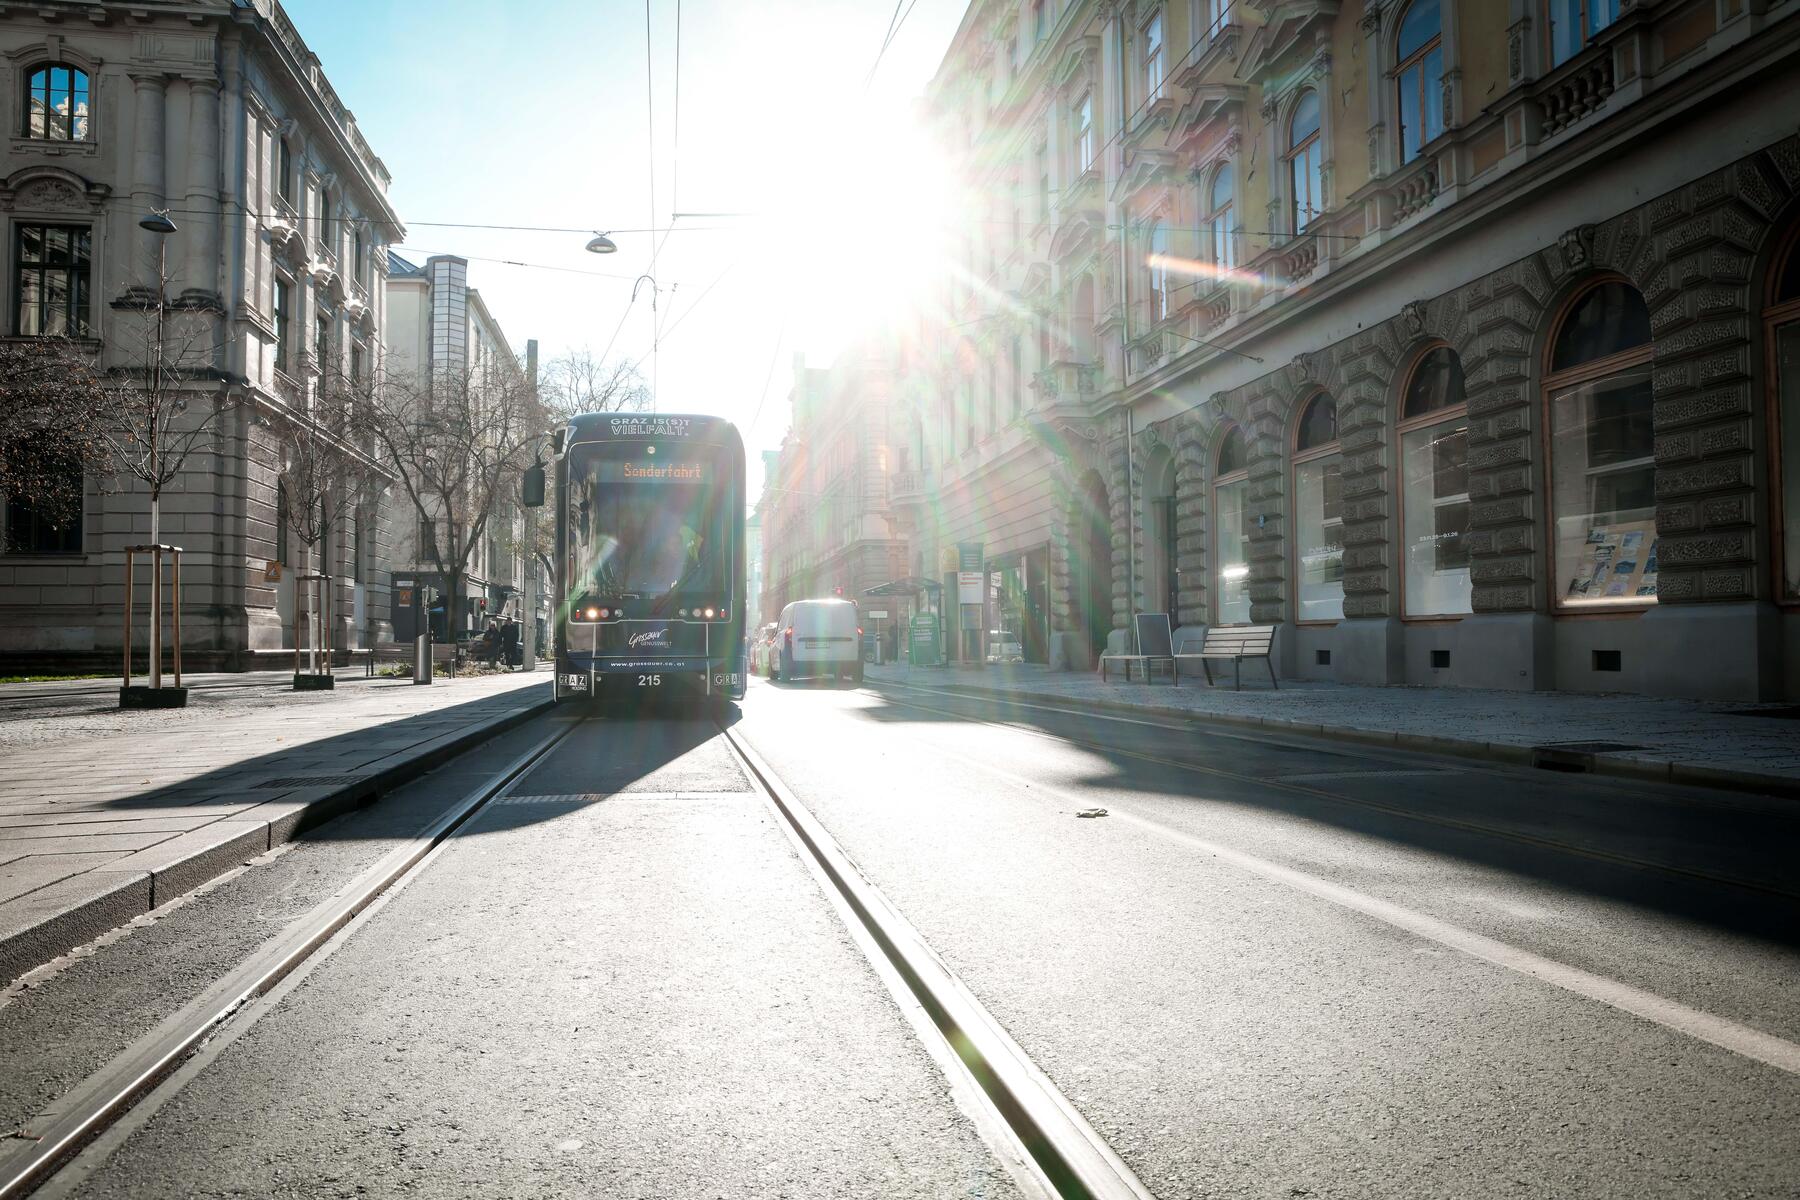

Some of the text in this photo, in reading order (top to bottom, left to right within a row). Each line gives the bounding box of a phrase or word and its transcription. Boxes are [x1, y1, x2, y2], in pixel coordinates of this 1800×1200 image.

[611, 424, 689, 436] VIELFALT.
[624, 463, 702, 478] Sonderfahrt
[638, 674, 661, 686] 215
